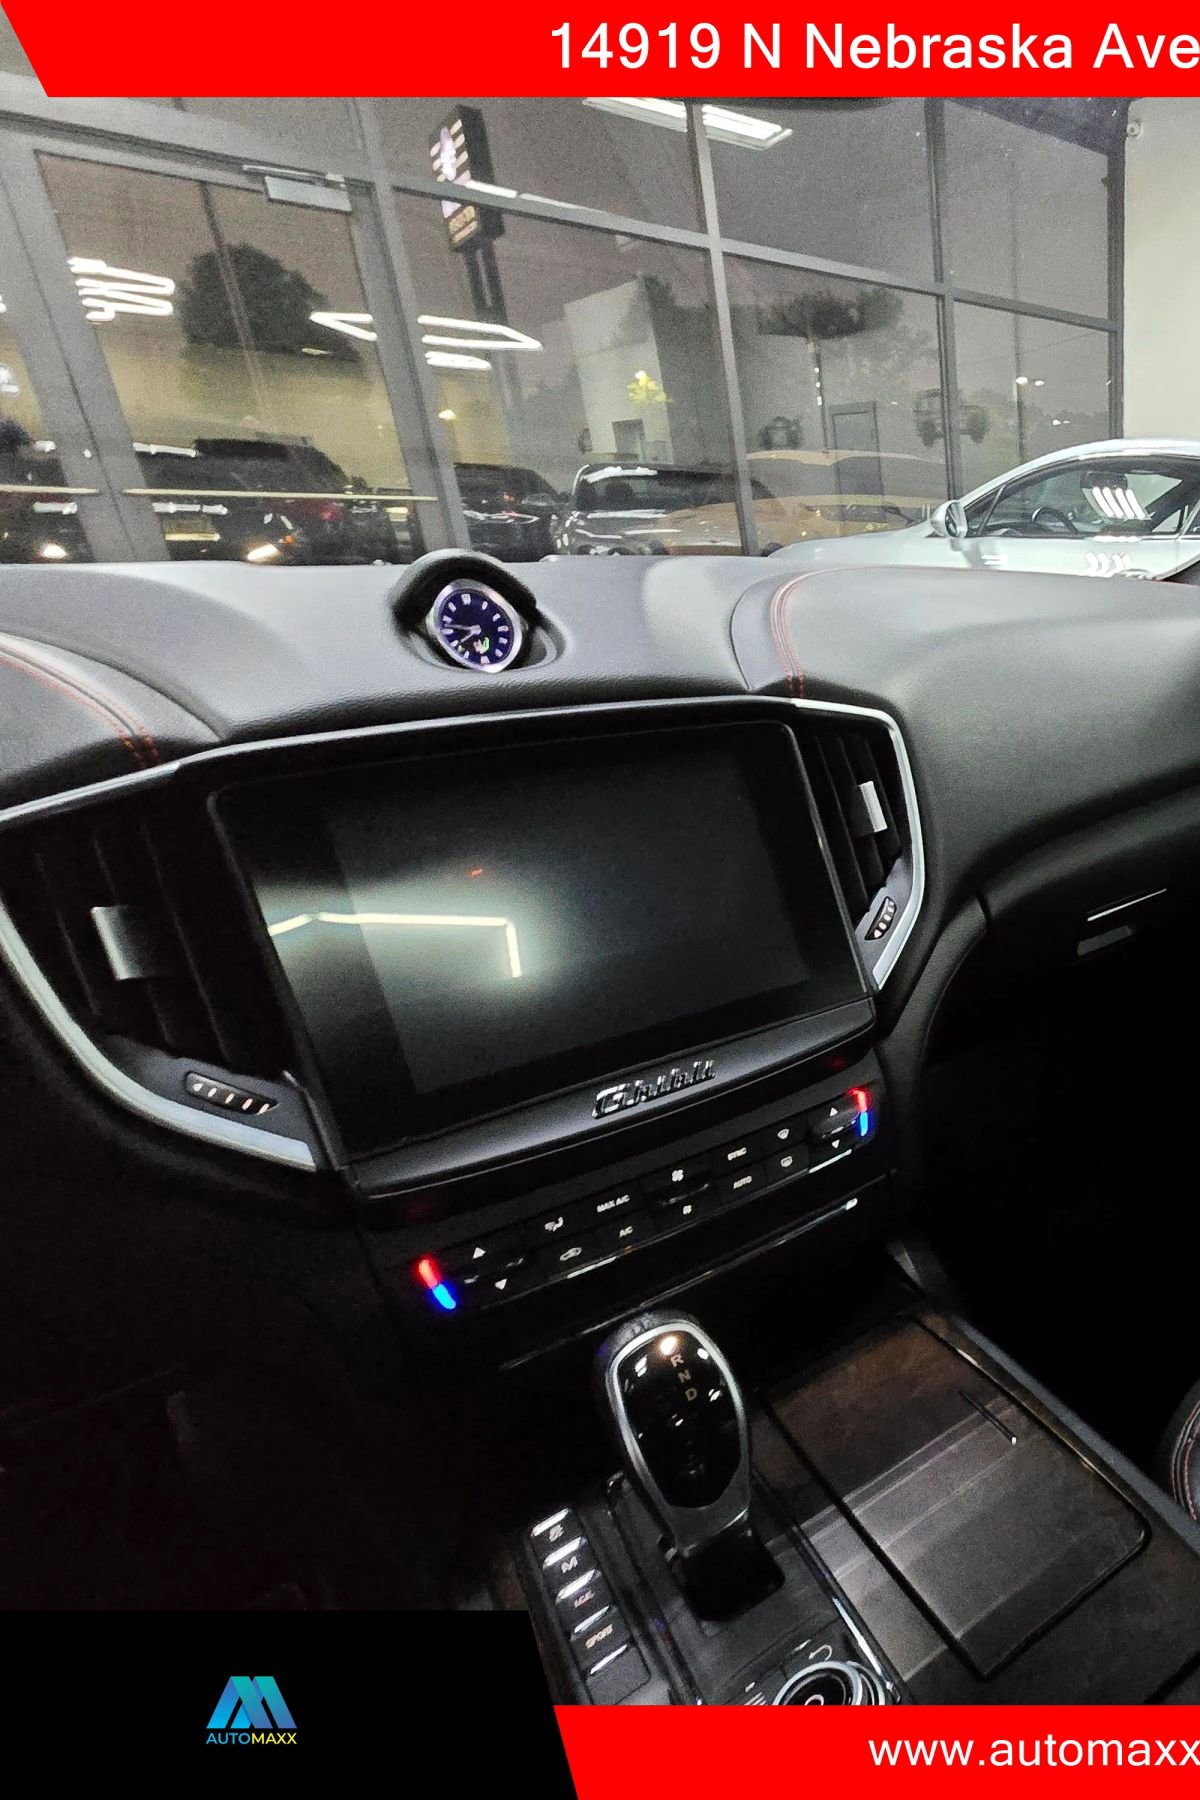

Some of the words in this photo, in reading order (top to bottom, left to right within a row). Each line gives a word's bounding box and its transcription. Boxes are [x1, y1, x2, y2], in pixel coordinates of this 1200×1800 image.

[670, 1353, 685, 1368] R
[678, 1369, 692, 1384] N
[685, 1387, 698, 1402] D
[560, 1555, 578, 1574] M
[585, 1623, 614, 1650] SPORT
